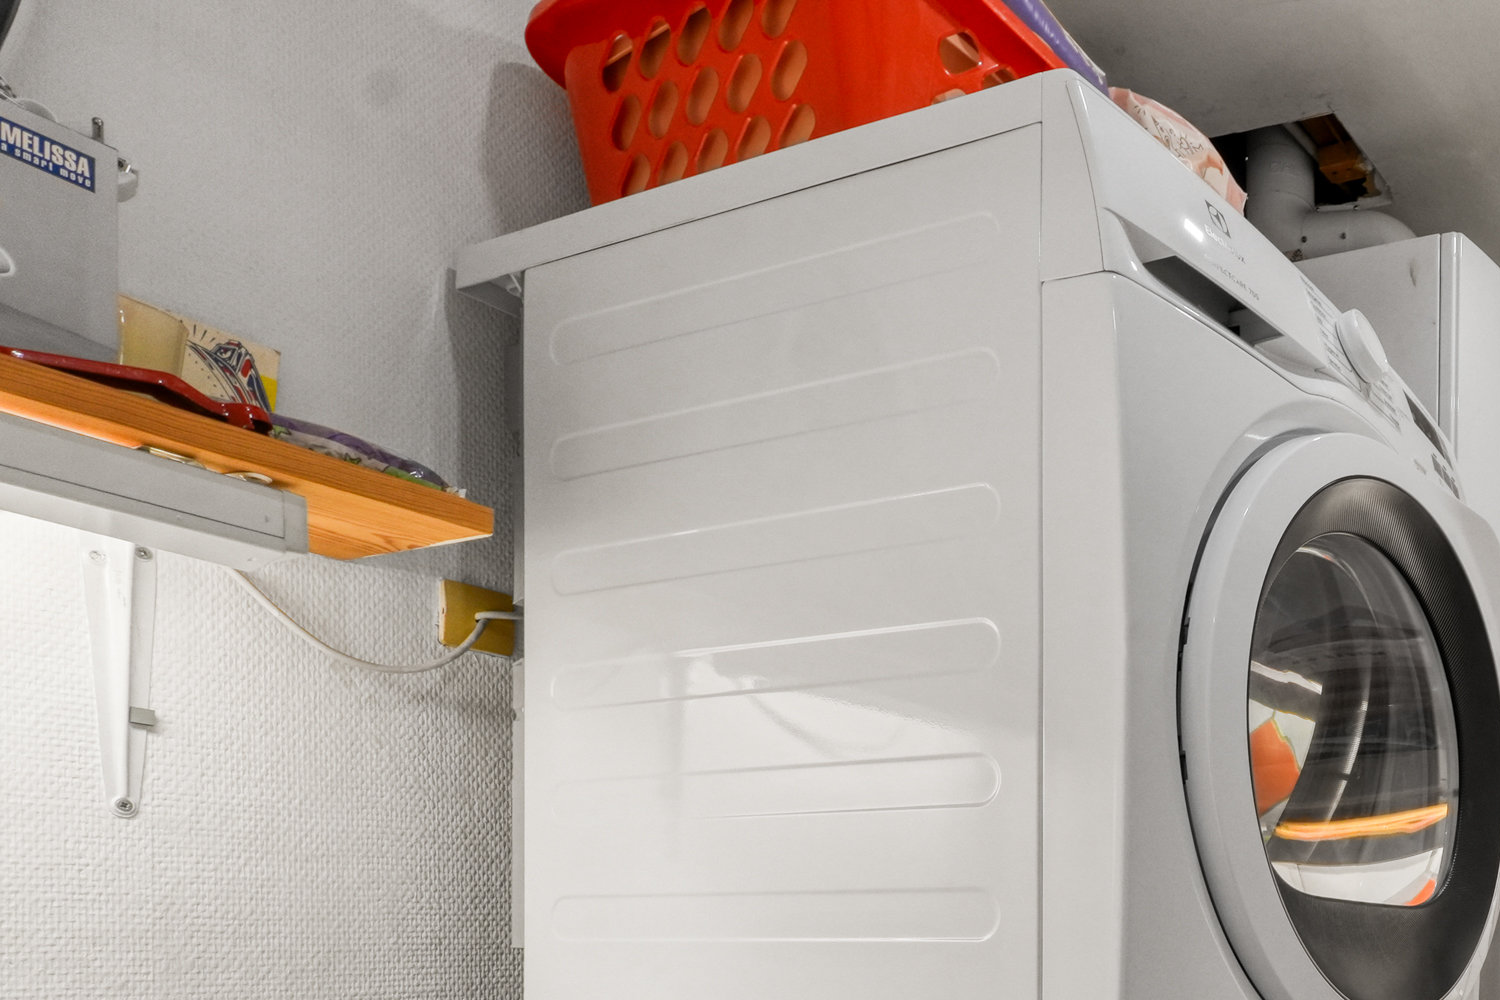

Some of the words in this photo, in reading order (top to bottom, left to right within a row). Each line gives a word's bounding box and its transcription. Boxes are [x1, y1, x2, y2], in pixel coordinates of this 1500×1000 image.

[1, 121, 90, 178] MELISSA
[15, 148, 52, 171] smart
[60, 168, 91, 187] move
